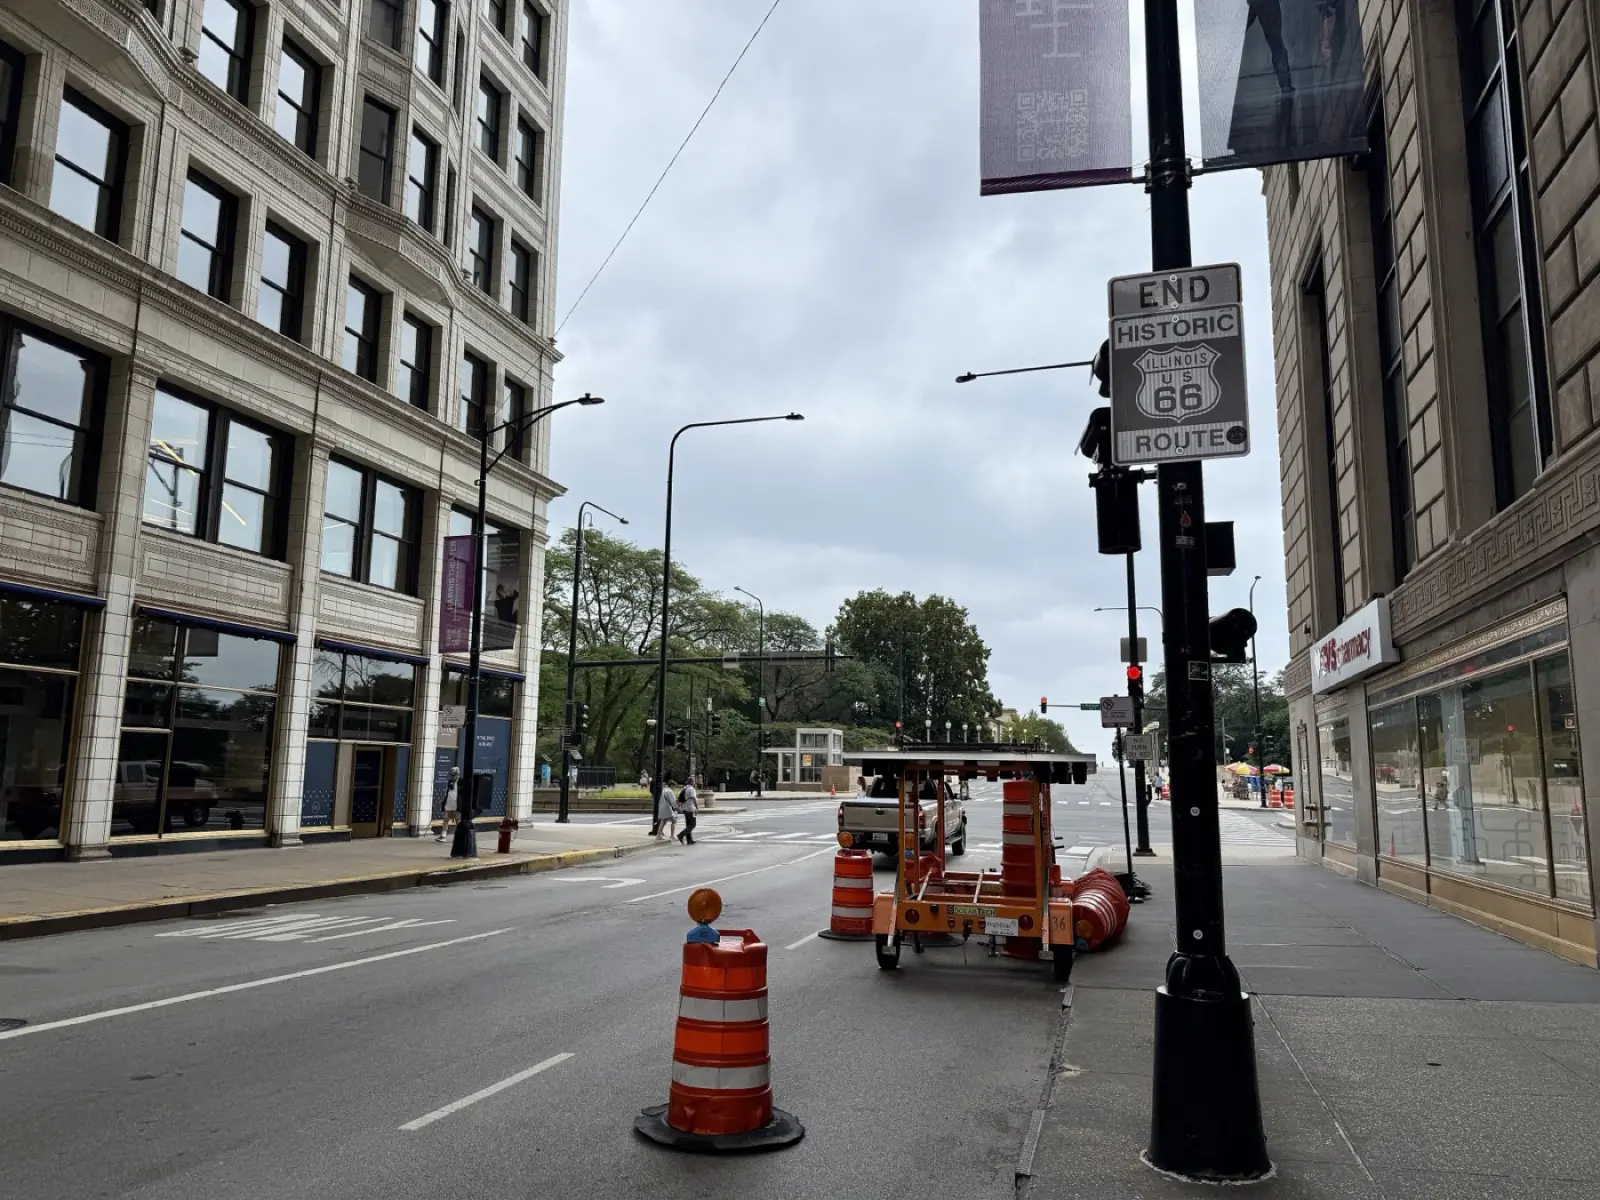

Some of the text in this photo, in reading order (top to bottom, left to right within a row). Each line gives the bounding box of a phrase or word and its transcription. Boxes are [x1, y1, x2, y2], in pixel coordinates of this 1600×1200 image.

[1139, 275, 1210, 308] END
[1117, 313, 1234, 344] HISTORIC
[1146, 352, 1208, 370] ILLINOIS
[1154, 383, 1203, 413] 66
[1135, 428, 1225, 453] ROUTE
